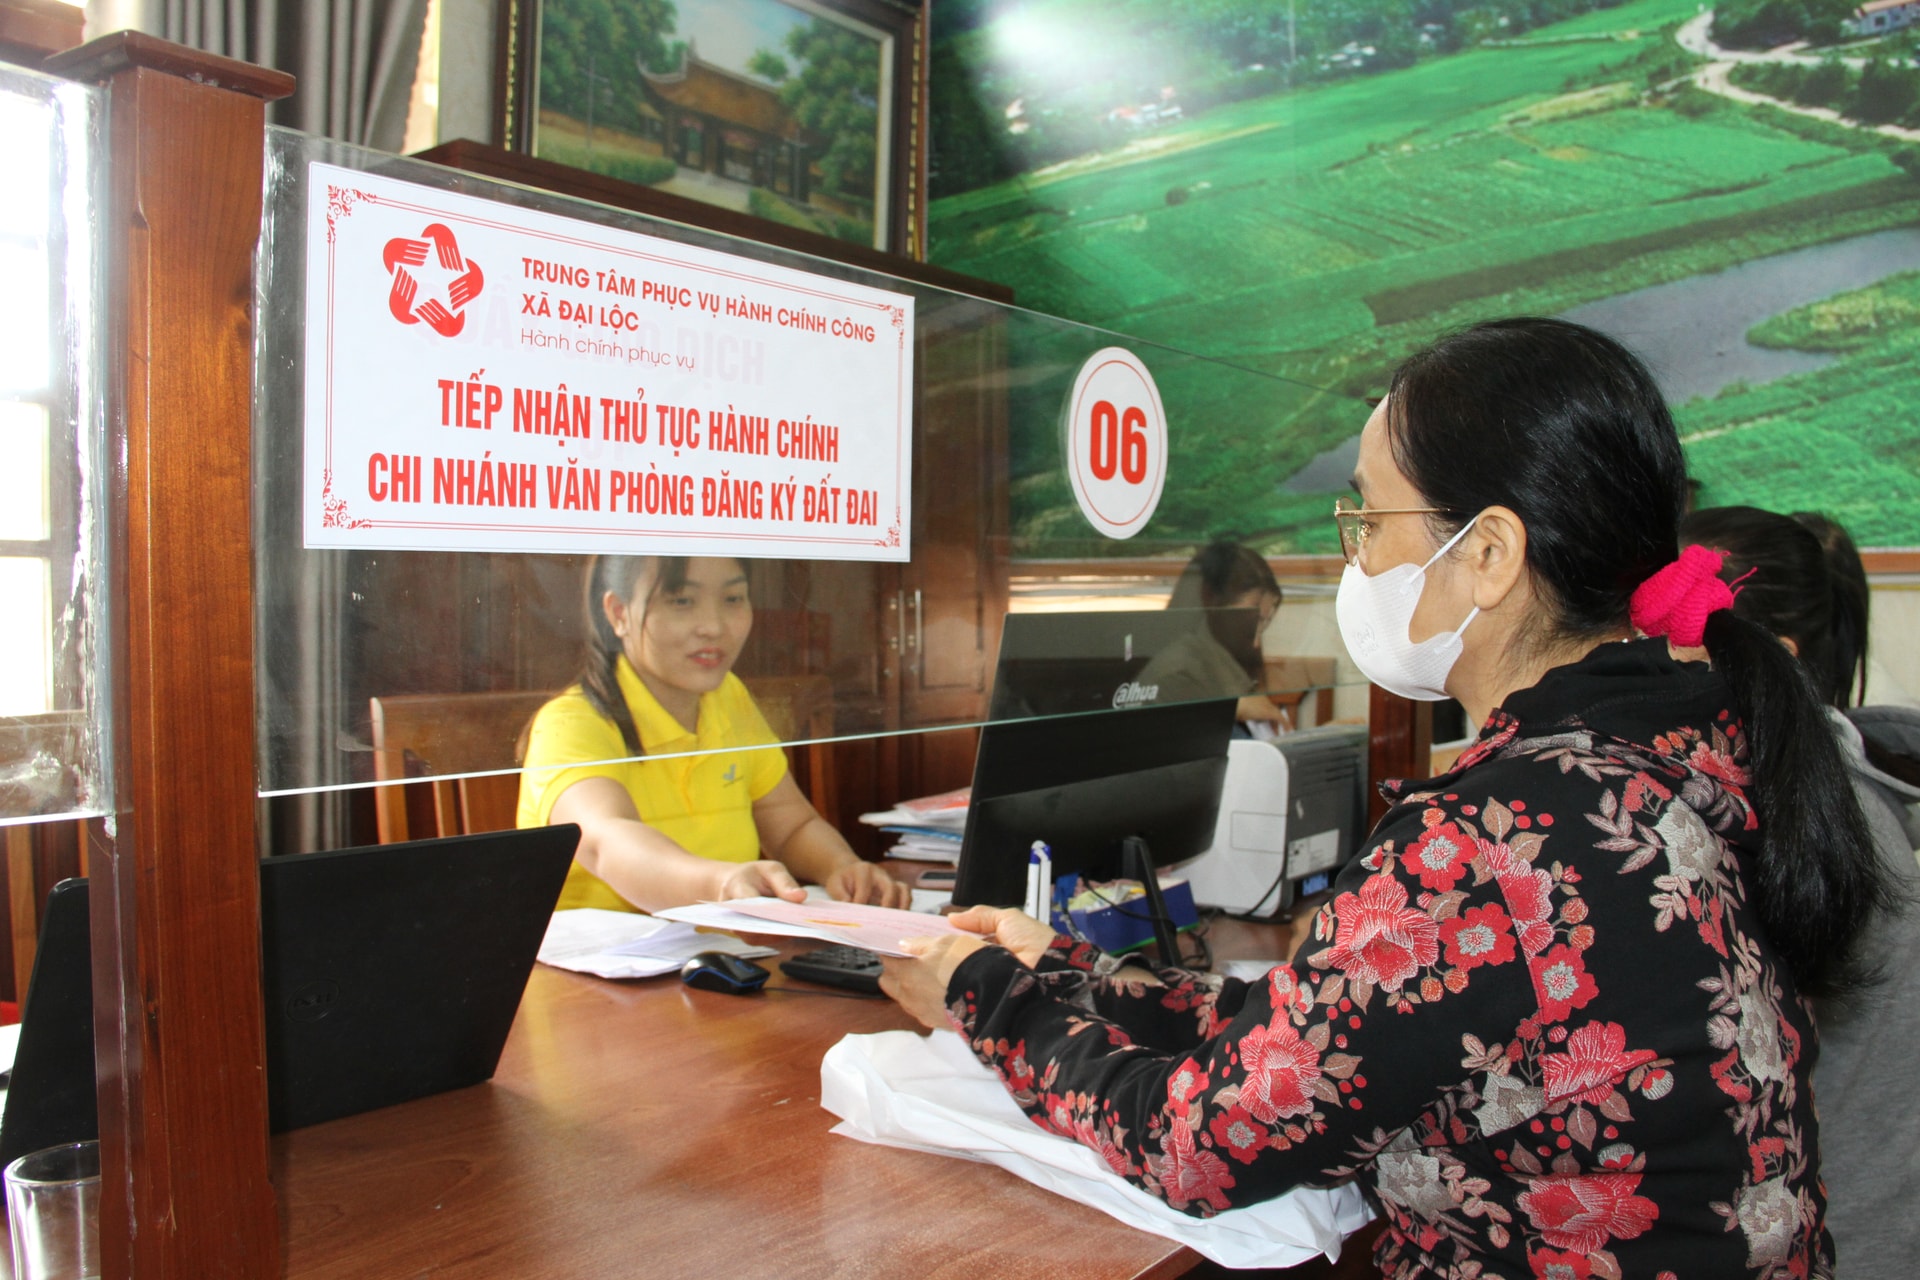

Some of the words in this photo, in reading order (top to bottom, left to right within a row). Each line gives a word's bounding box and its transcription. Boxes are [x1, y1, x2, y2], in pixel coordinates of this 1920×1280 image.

[521, 291, 551, 318] XÃ
[558, 299, 593, 329] ĐẠI
[600, 303, 639, 335] LỘC
[522, 257, 590, 289] TRUNG
[596, 268, 636, 298] TÂM
[642, 280, 692, 311] PHỤC
[697, 291, 720, 318] VỤ
[726, 294, 772, 323] HÀNH
[777, 307, 827, 334] CHÍNH
[831, 316, 876, 343] CÔNG
[521, 327, 570, 351] Hành
[575, 338, 624, 358] chính
[628, 346, 671, 367] phục
[676, 355, 695, 372] vụ
[438, 368, 503, 430] TIẾP
[513, 383, 591, 447] NHẬN
[600, 387, 648, 445] THỦ
[656, 404, 701, 457] TỤC
[708, 404, 769, 456] HÀNH
[777, 415, 839, 463] CHÍNH
[1090, 400, 1147, 485] 06
[368, 452, 421, 503] CHI
[433, 451, 537, 508] NHÁNH
[547, 457, 600, 512] VĂN
[610, 462, 694, 516] PHÒNG
[702, 469, 763, 520] ĐĂNG
[771, 475, 797, 521] KÝ
[803, 473, 841, 524] ĐẤT
[847, 488, 878, 526] ĐAI
